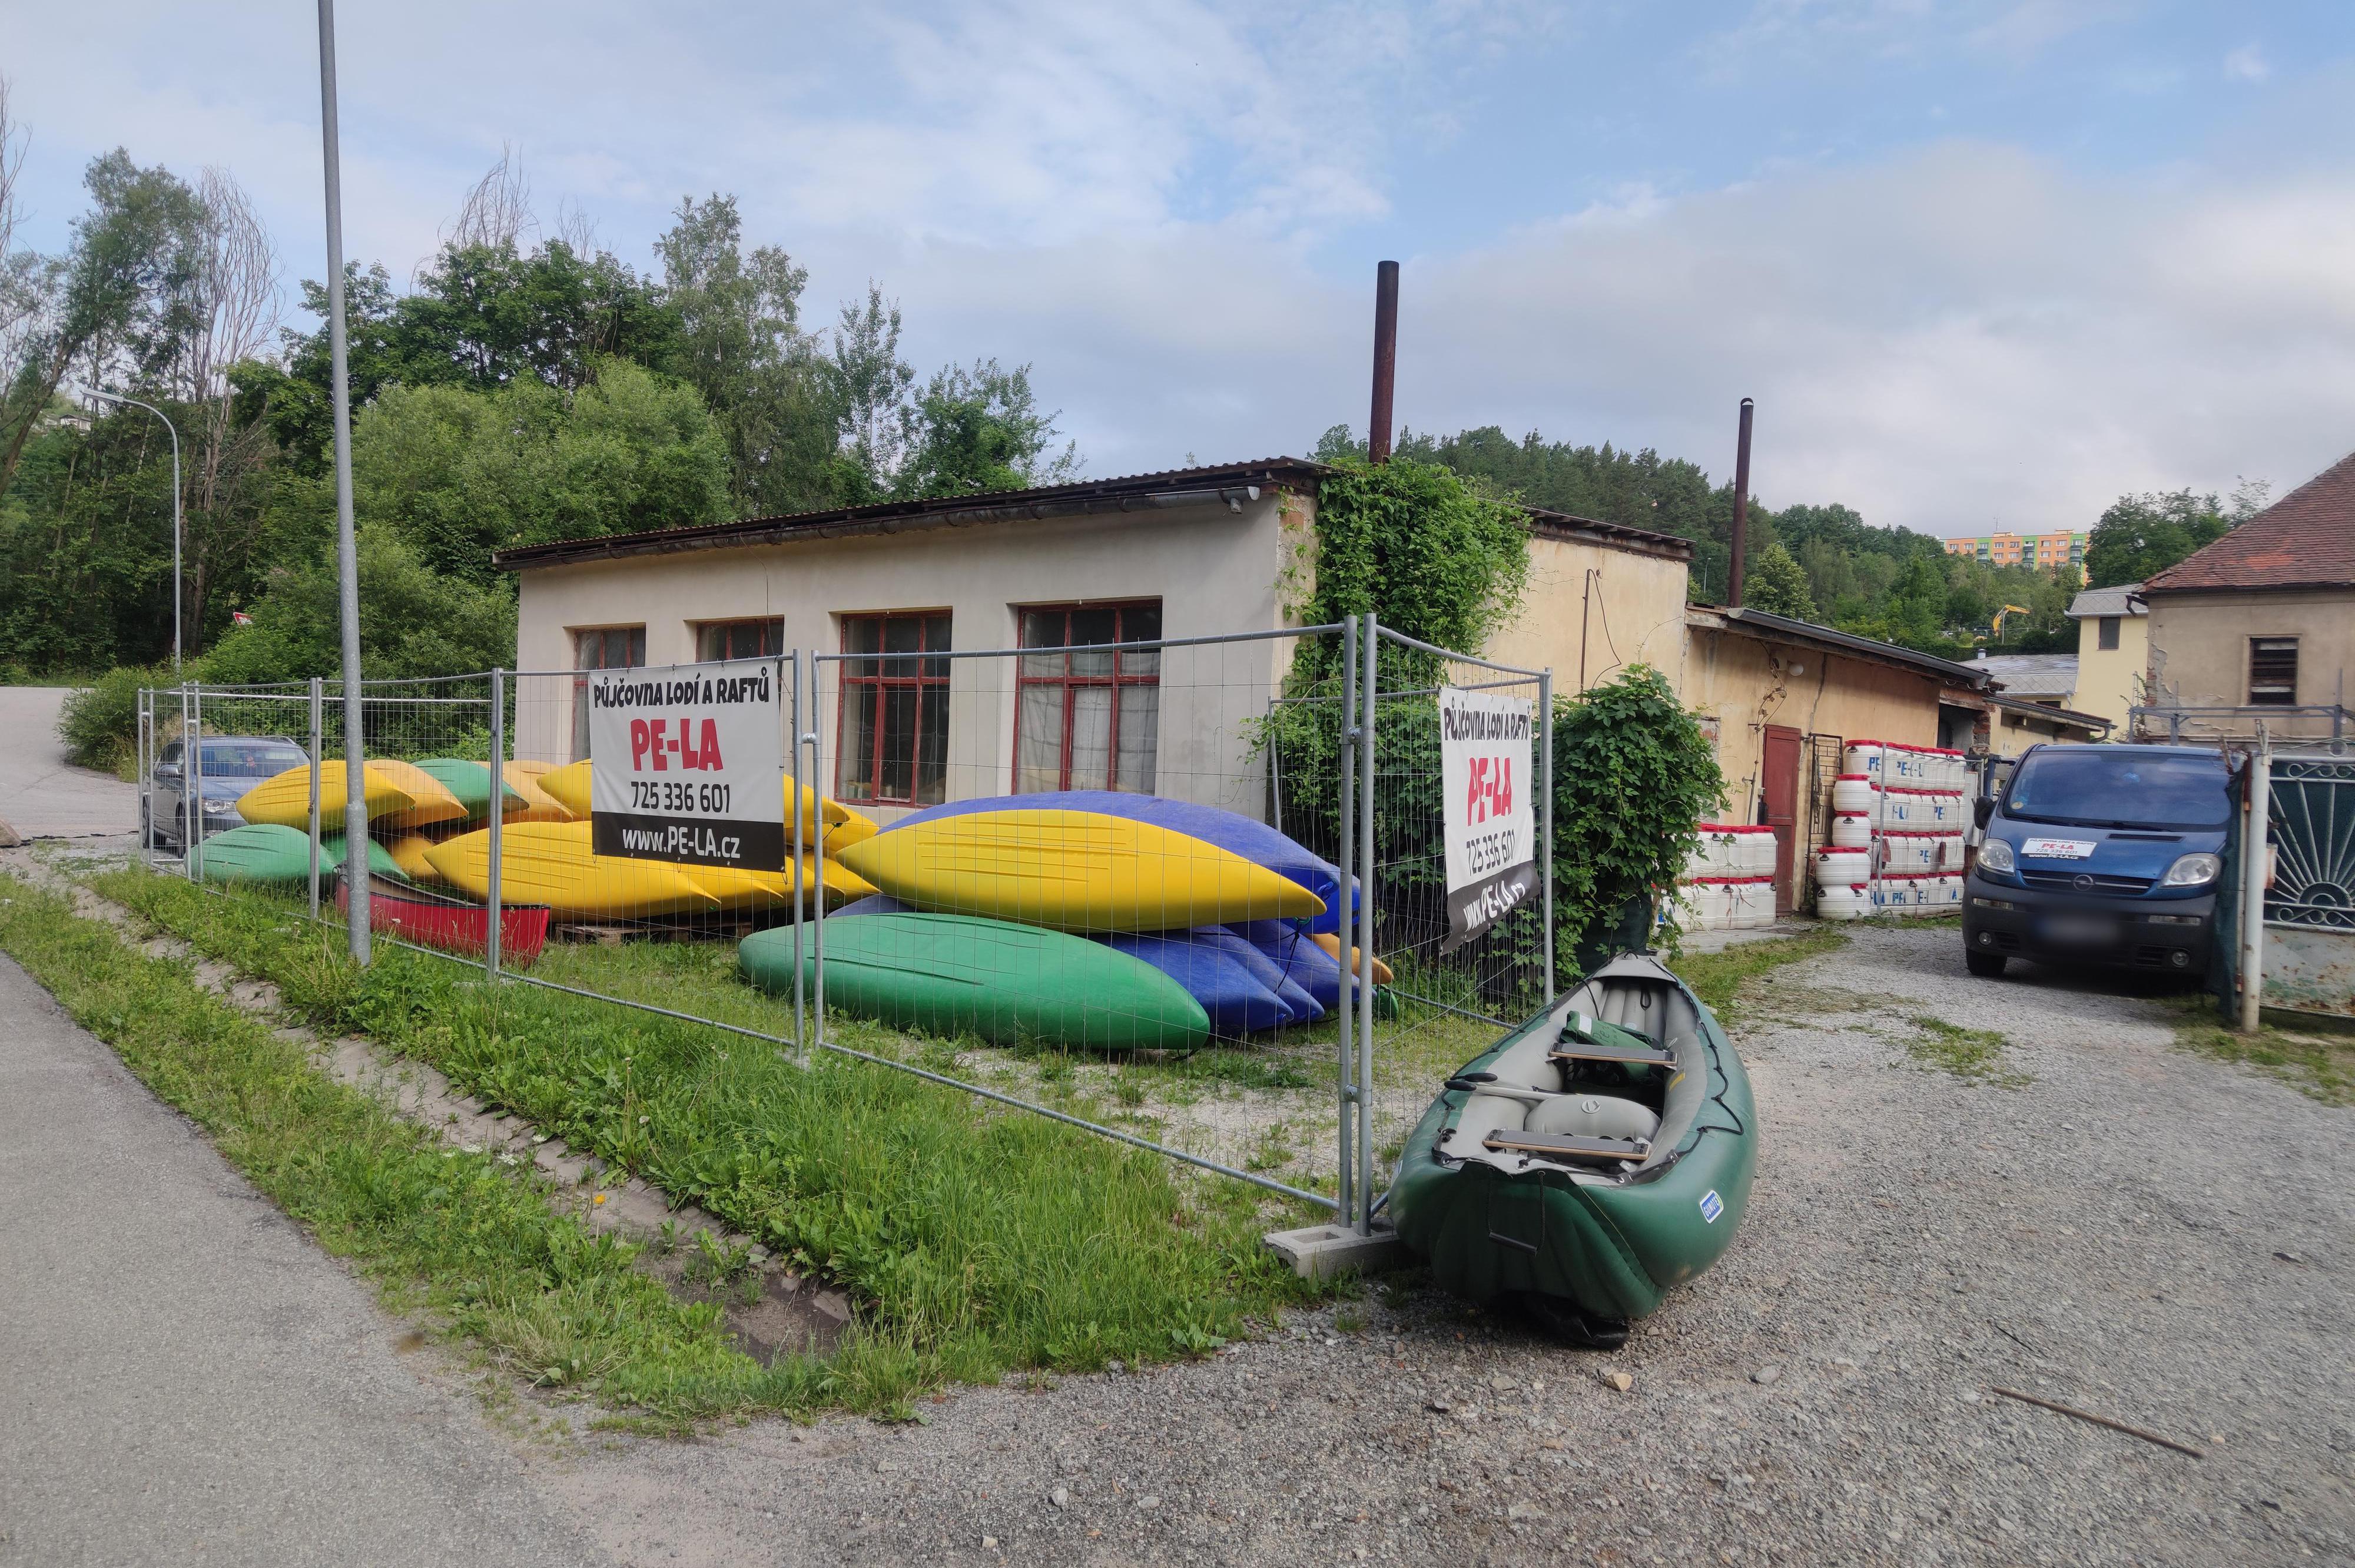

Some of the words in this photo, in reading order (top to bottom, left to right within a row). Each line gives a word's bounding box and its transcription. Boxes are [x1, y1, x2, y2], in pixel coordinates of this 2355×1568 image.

[593, 675, 663, 708] PŮJČOVNA
[666, 672, 701, 705] LODÍ
[702, 679, 712, 705] A
[716, 666, 769, 704] RAFTŮ
[1444, 696, 1485, 741] PŮJČOVNA
[1487, 704, 1504, 741] LODÍ
[1504, 713, 1510, 741] A
[1510, 705, 1531, 741] RAFTŮ
[630, 718, 724, 771] PE-LA
[631, 781, 659, 810] 725
[664, 783, 694, 812] 336
[699, 783, 730, 814] 601
[1467, 757, 1512, 827] PE-LA
[622, 826, 741, 859] www.PE-LA.cz
[1467, 837, 1484, 876] 725
[1483, 833, 1501, 870] 336
[1501, 828, 1515, 864] 601
